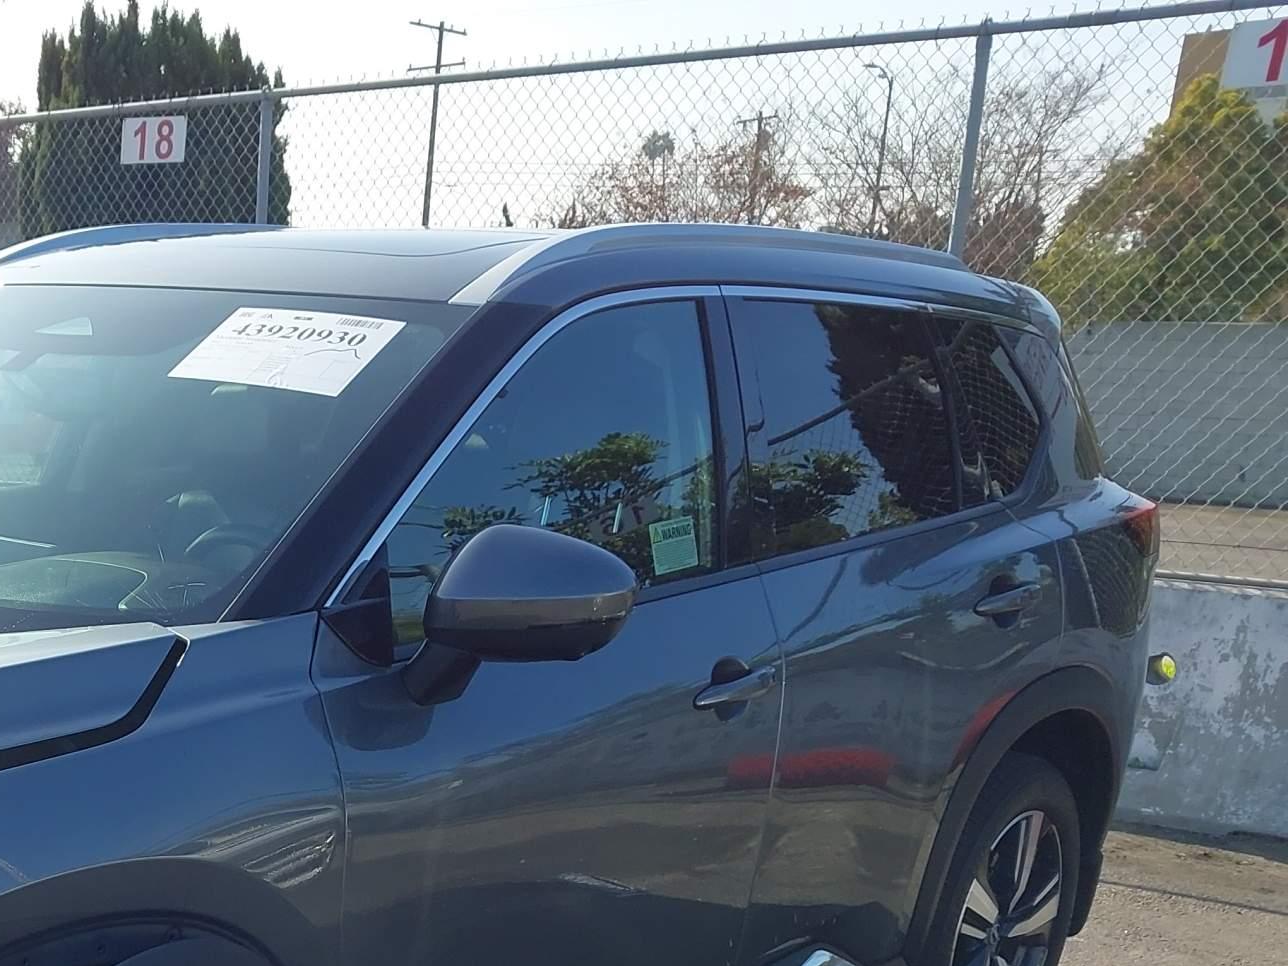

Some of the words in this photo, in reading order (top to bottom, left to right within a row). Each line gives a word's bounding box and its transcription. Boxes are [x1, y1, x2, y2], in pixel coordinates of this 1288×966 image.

[134, 119, 174, 160] 18
[232, 323, 367, 346] 43920930
[661, 523, 692, 540] WARNING
